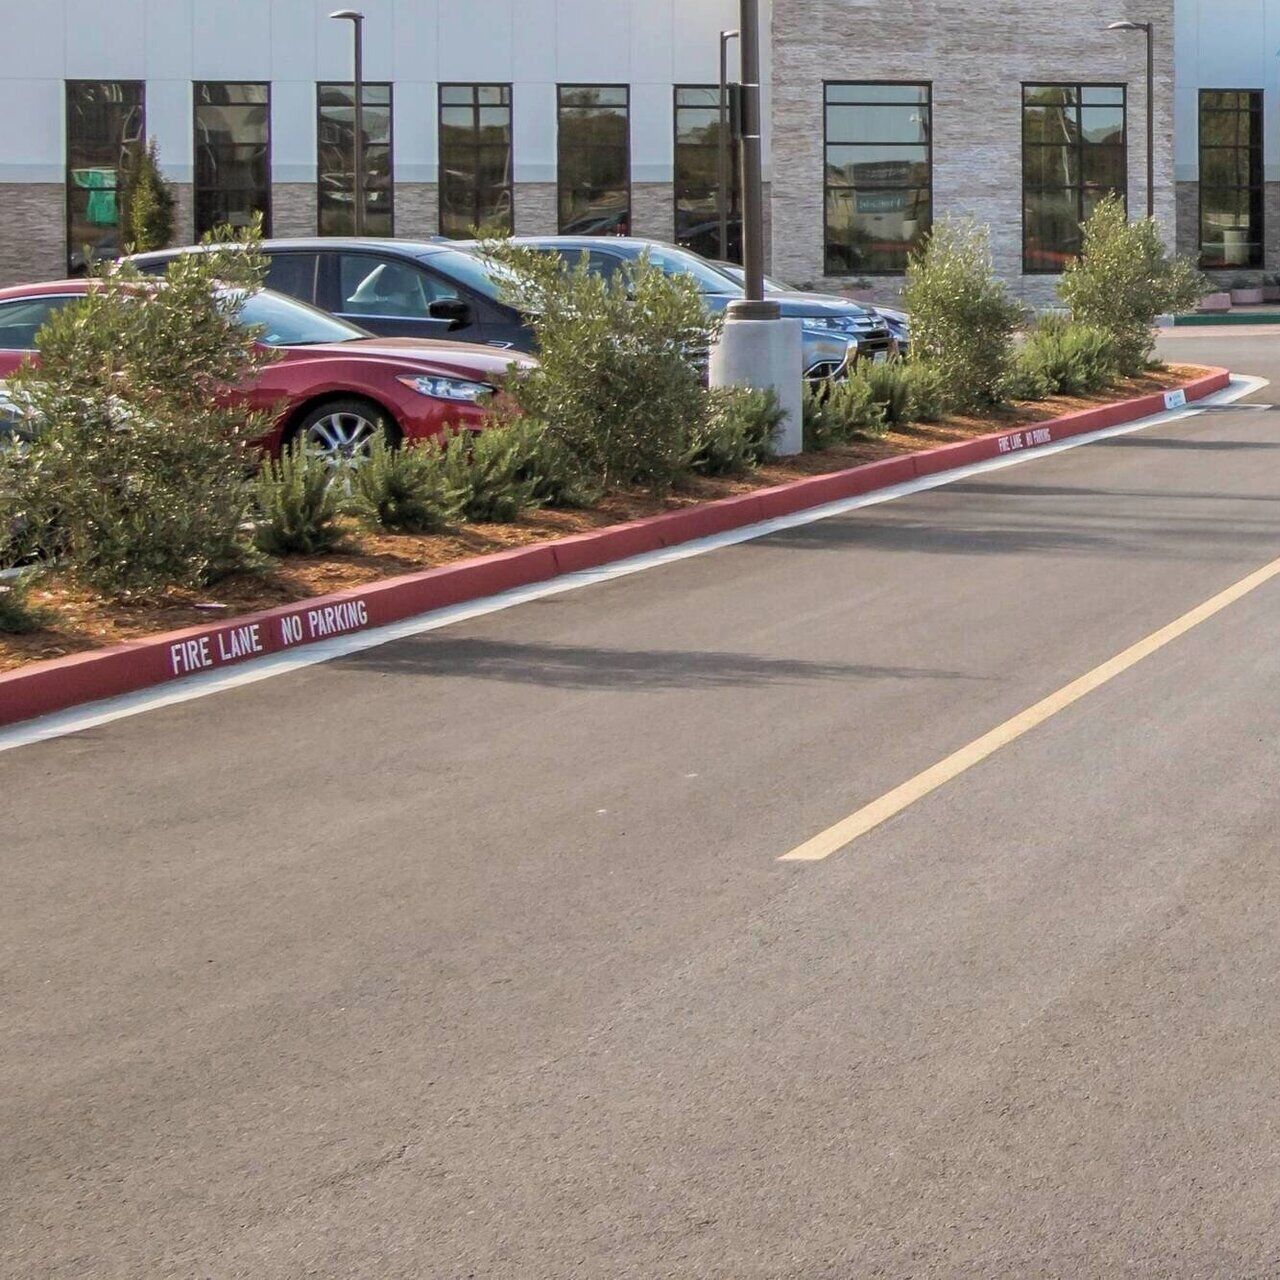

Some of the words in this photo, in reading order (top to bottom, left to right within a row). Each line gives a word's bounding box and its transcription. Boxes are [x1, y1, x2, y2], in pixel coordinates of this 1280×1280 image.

[171, 637, 212, 675] FIRE
[218, 624, 262, 661] LANE
[281, 616, 302, 645] NO
[308, 600, 368, 637] PARKING
